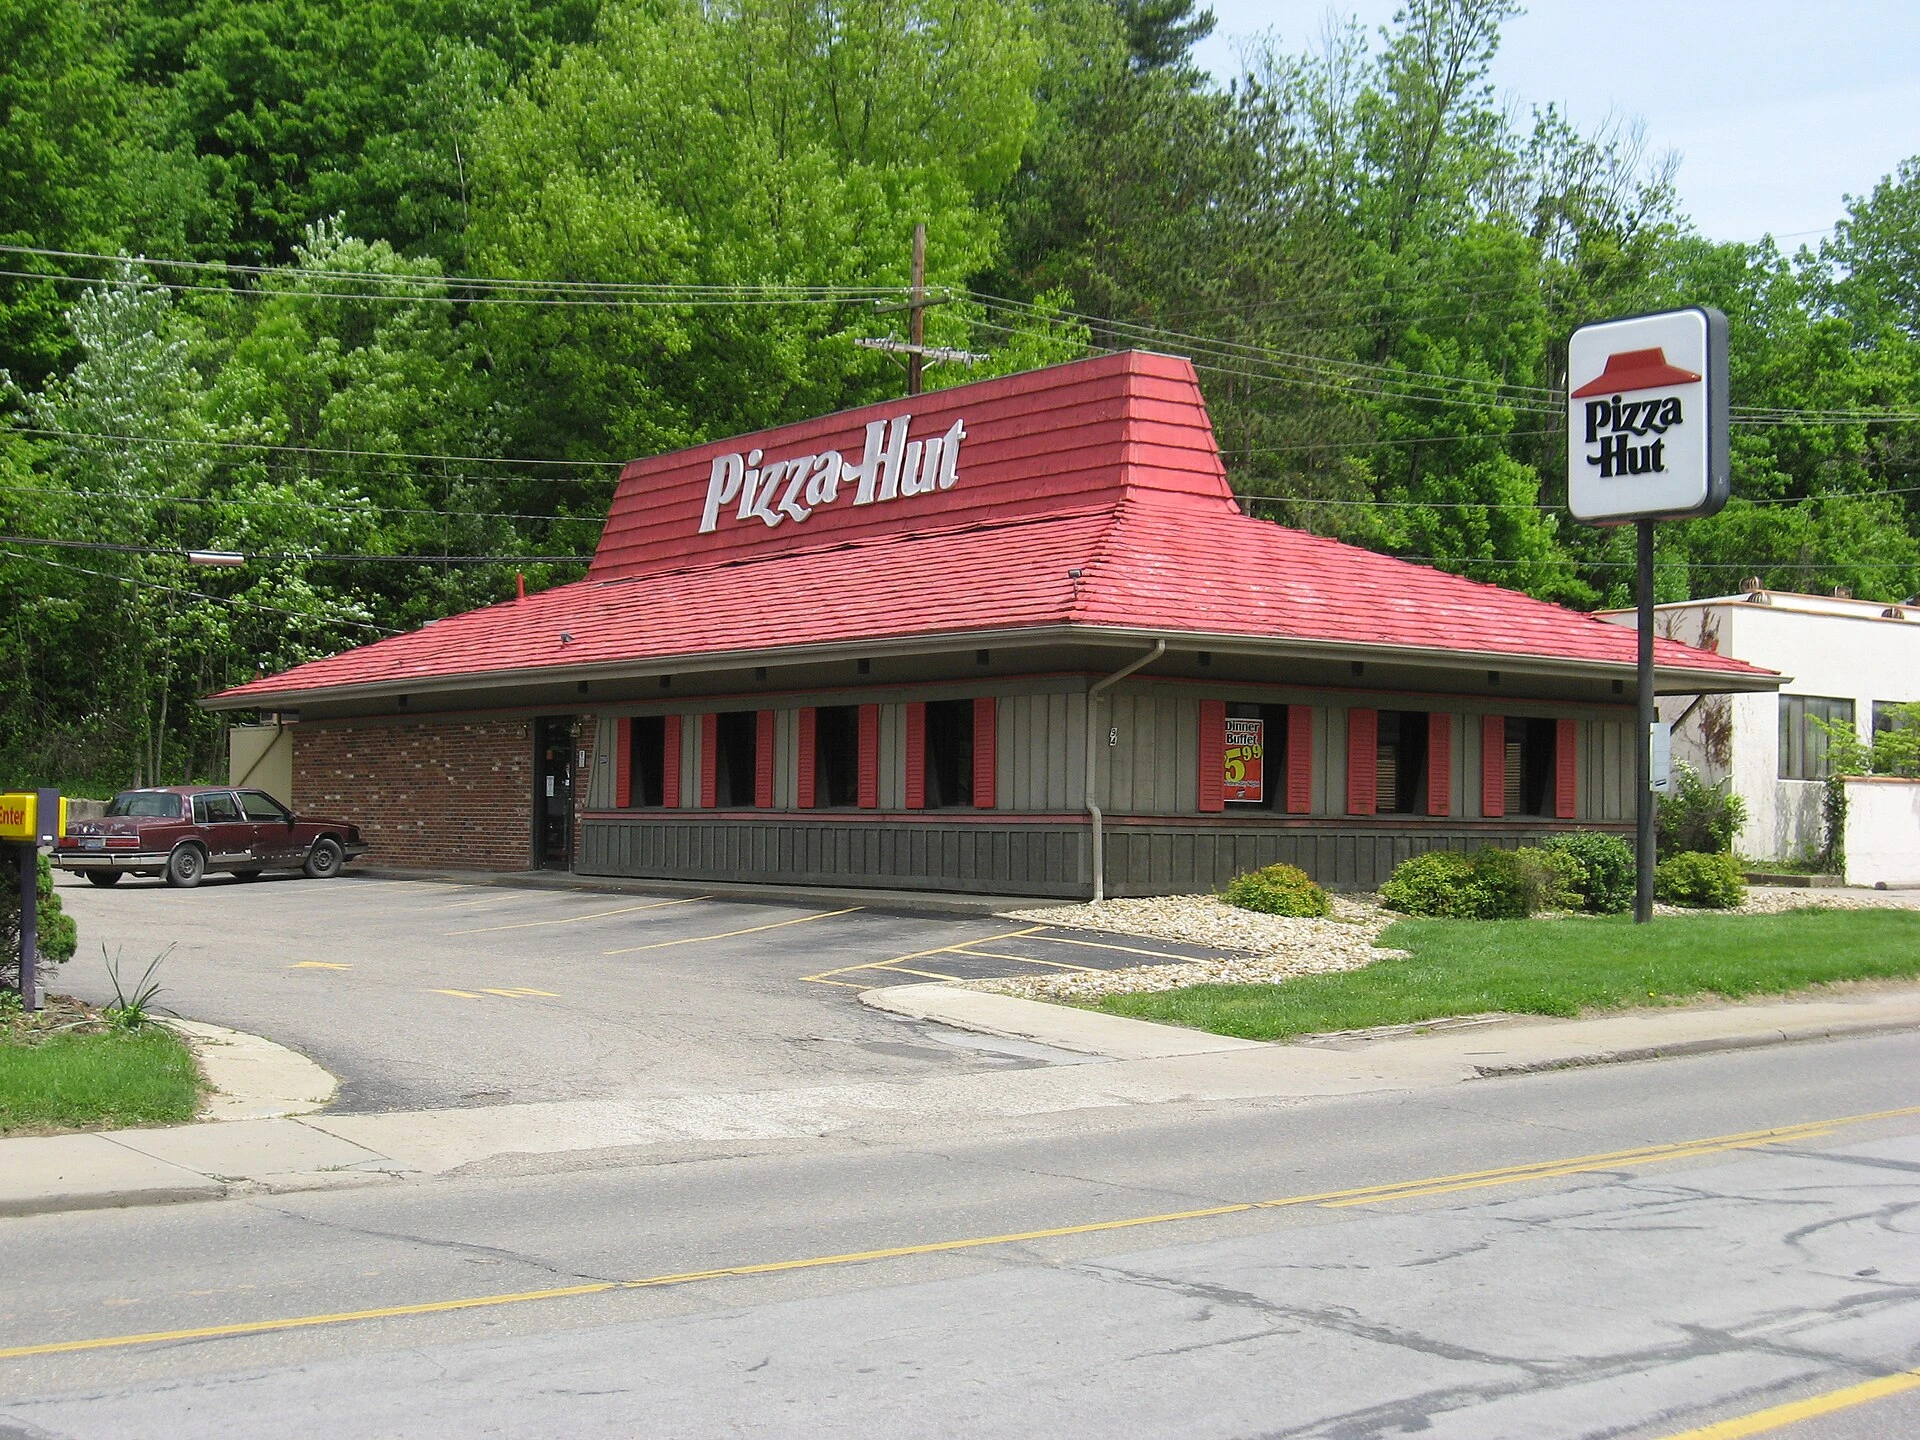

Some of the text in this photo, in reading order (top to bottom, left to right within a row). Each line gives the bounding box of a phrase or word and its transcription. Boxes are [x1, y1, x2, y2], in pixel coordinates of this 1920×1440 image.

[1585, 395, 1684, 443] Pizza
[698, 414, 967, 534] Pizza Hut
[1586, 434, 1665, 478] Hut
[1224, 720, 1260, 733] Dinner
[1225, 732, 1259, 746] Buffet
